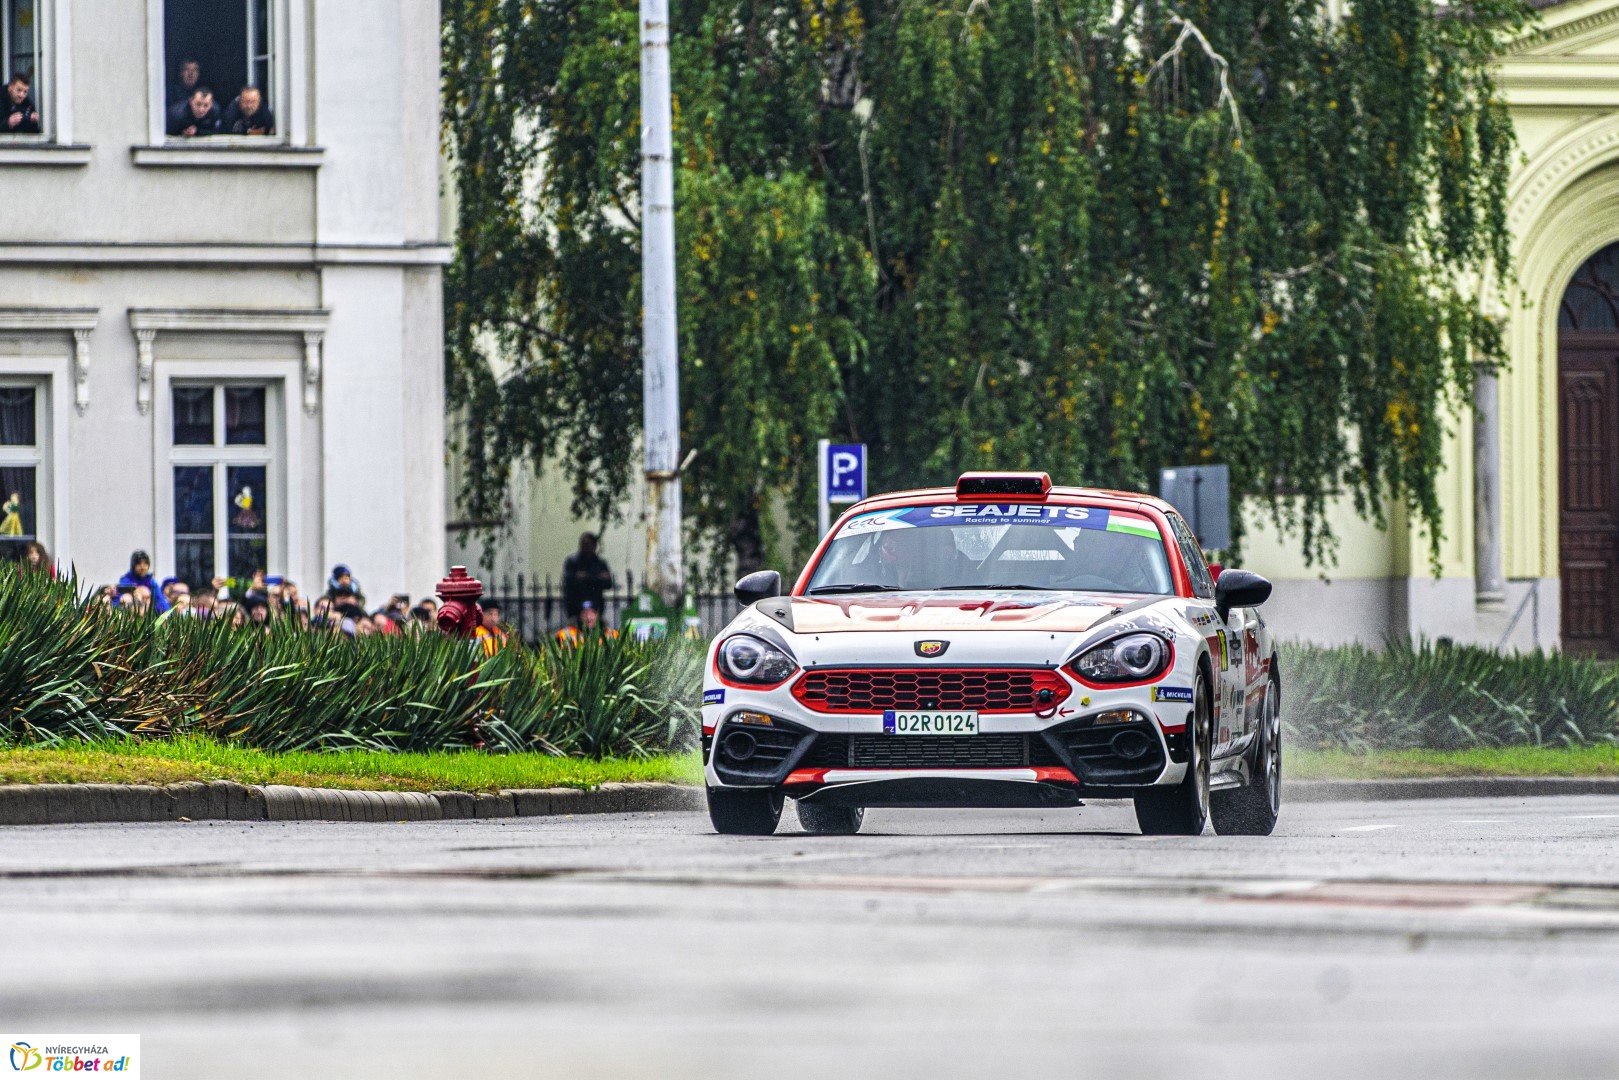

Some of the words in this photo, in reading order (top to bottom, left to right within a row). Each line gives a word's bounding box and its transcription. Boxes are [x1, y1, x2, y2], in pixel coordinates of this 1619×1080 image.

[832, 452, 858, 488] P
[930, 504, 1089, 520] SEAJETS
[965, 517, 997, 525] Racing
[1012, 517, 1051, 525] summer
[1166, 691, 1192, 699] MICHELIN
